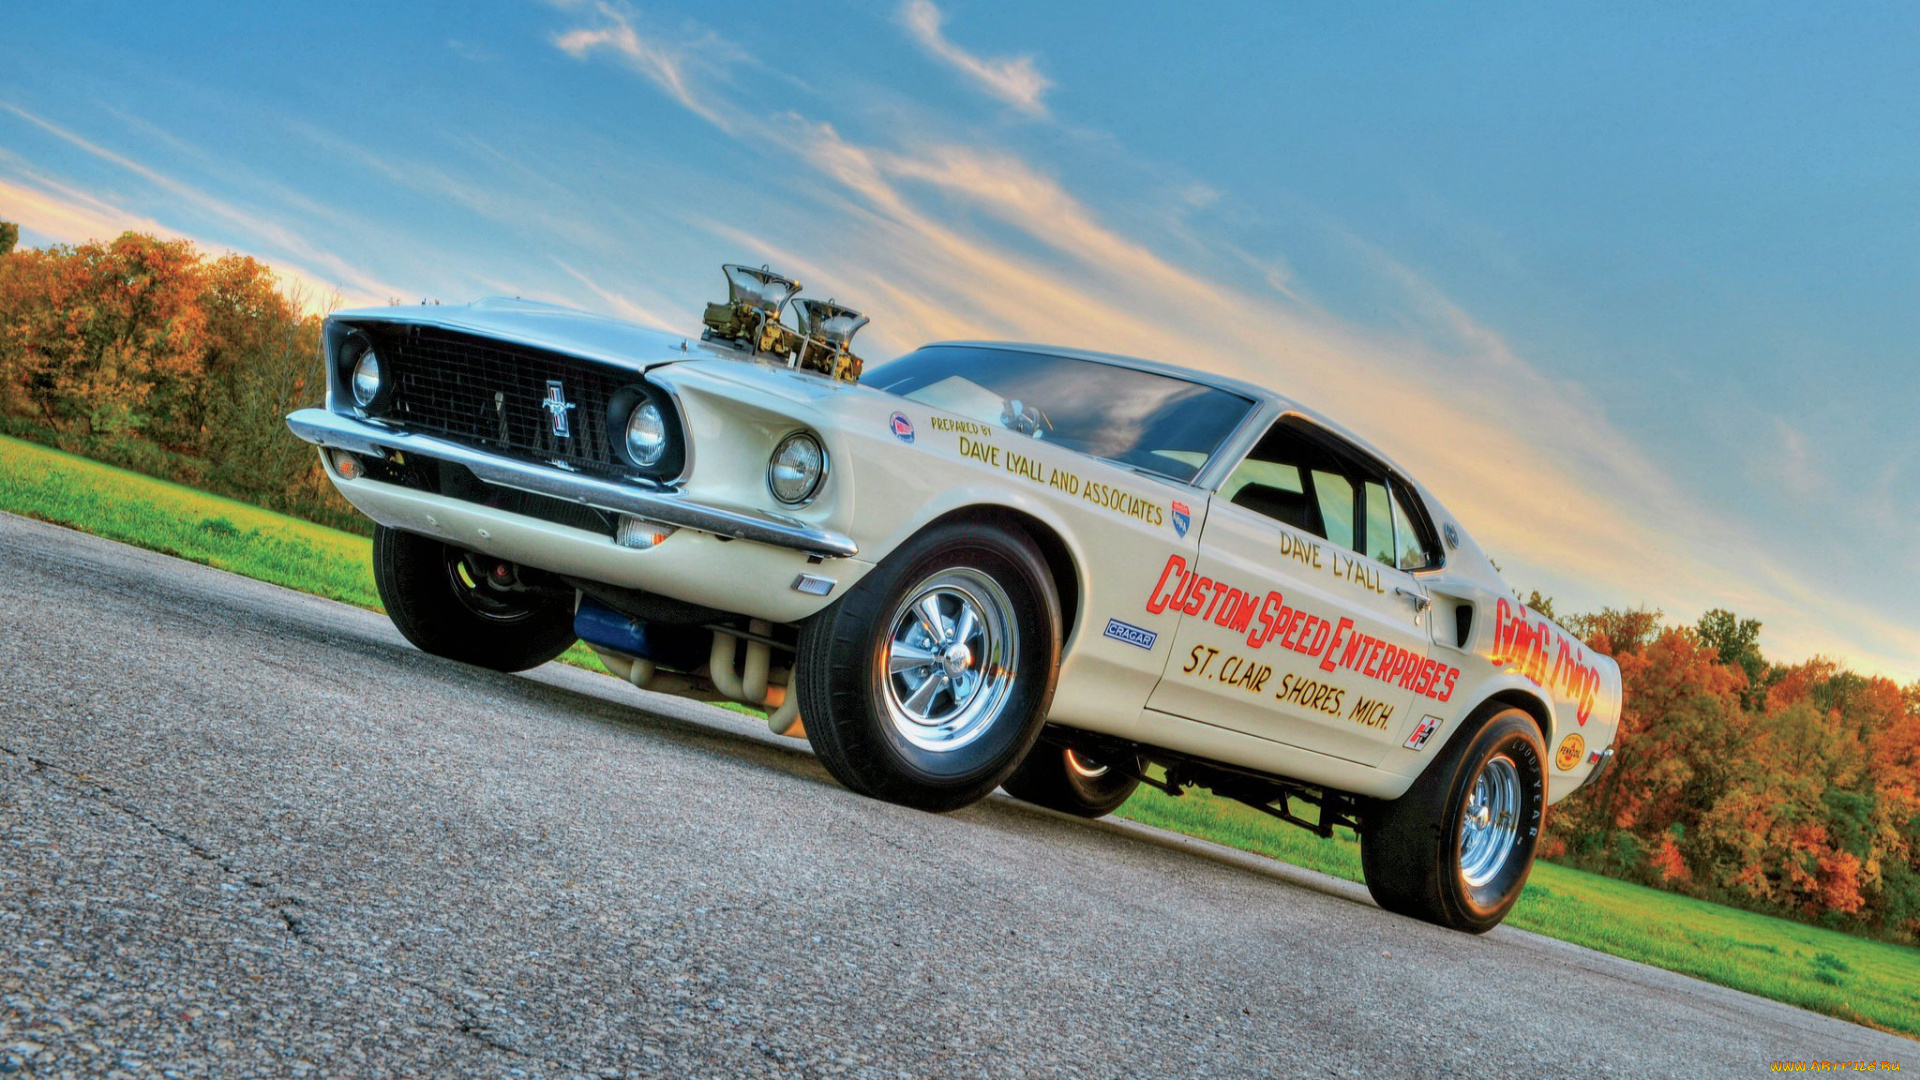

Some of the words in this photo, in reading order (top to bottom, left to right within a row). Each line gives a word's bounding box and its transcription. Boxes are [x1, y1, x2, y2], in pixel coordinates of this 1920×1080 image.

[930, 416, 979, 434] PREPARED
[980, 425, 992, 436] BY
[959, 435, 1000, 467] DAVE
[1006, 451, 1045, 483] LYALL
[1049, 468, 1079, 495] AND
[1082, 480, 1163, 526] ASSOCIATES
[1280, 530, 1322, 570] DAVE
[1333, 551, 1385, 594] LYALL
[1109, 624, 1151, 646] CRAGAR
[1146, 554, 1260, 634] CUSTOM
[1246, 591, 1331, 657] SPEED
[1319, 616, 1460, 702] ENTERPRISES
[1183, 645, 1219, 680] ST.
[1218, 655, 1272, 693] CLAIR
[1348, 695, 1395, 730] MICH.
